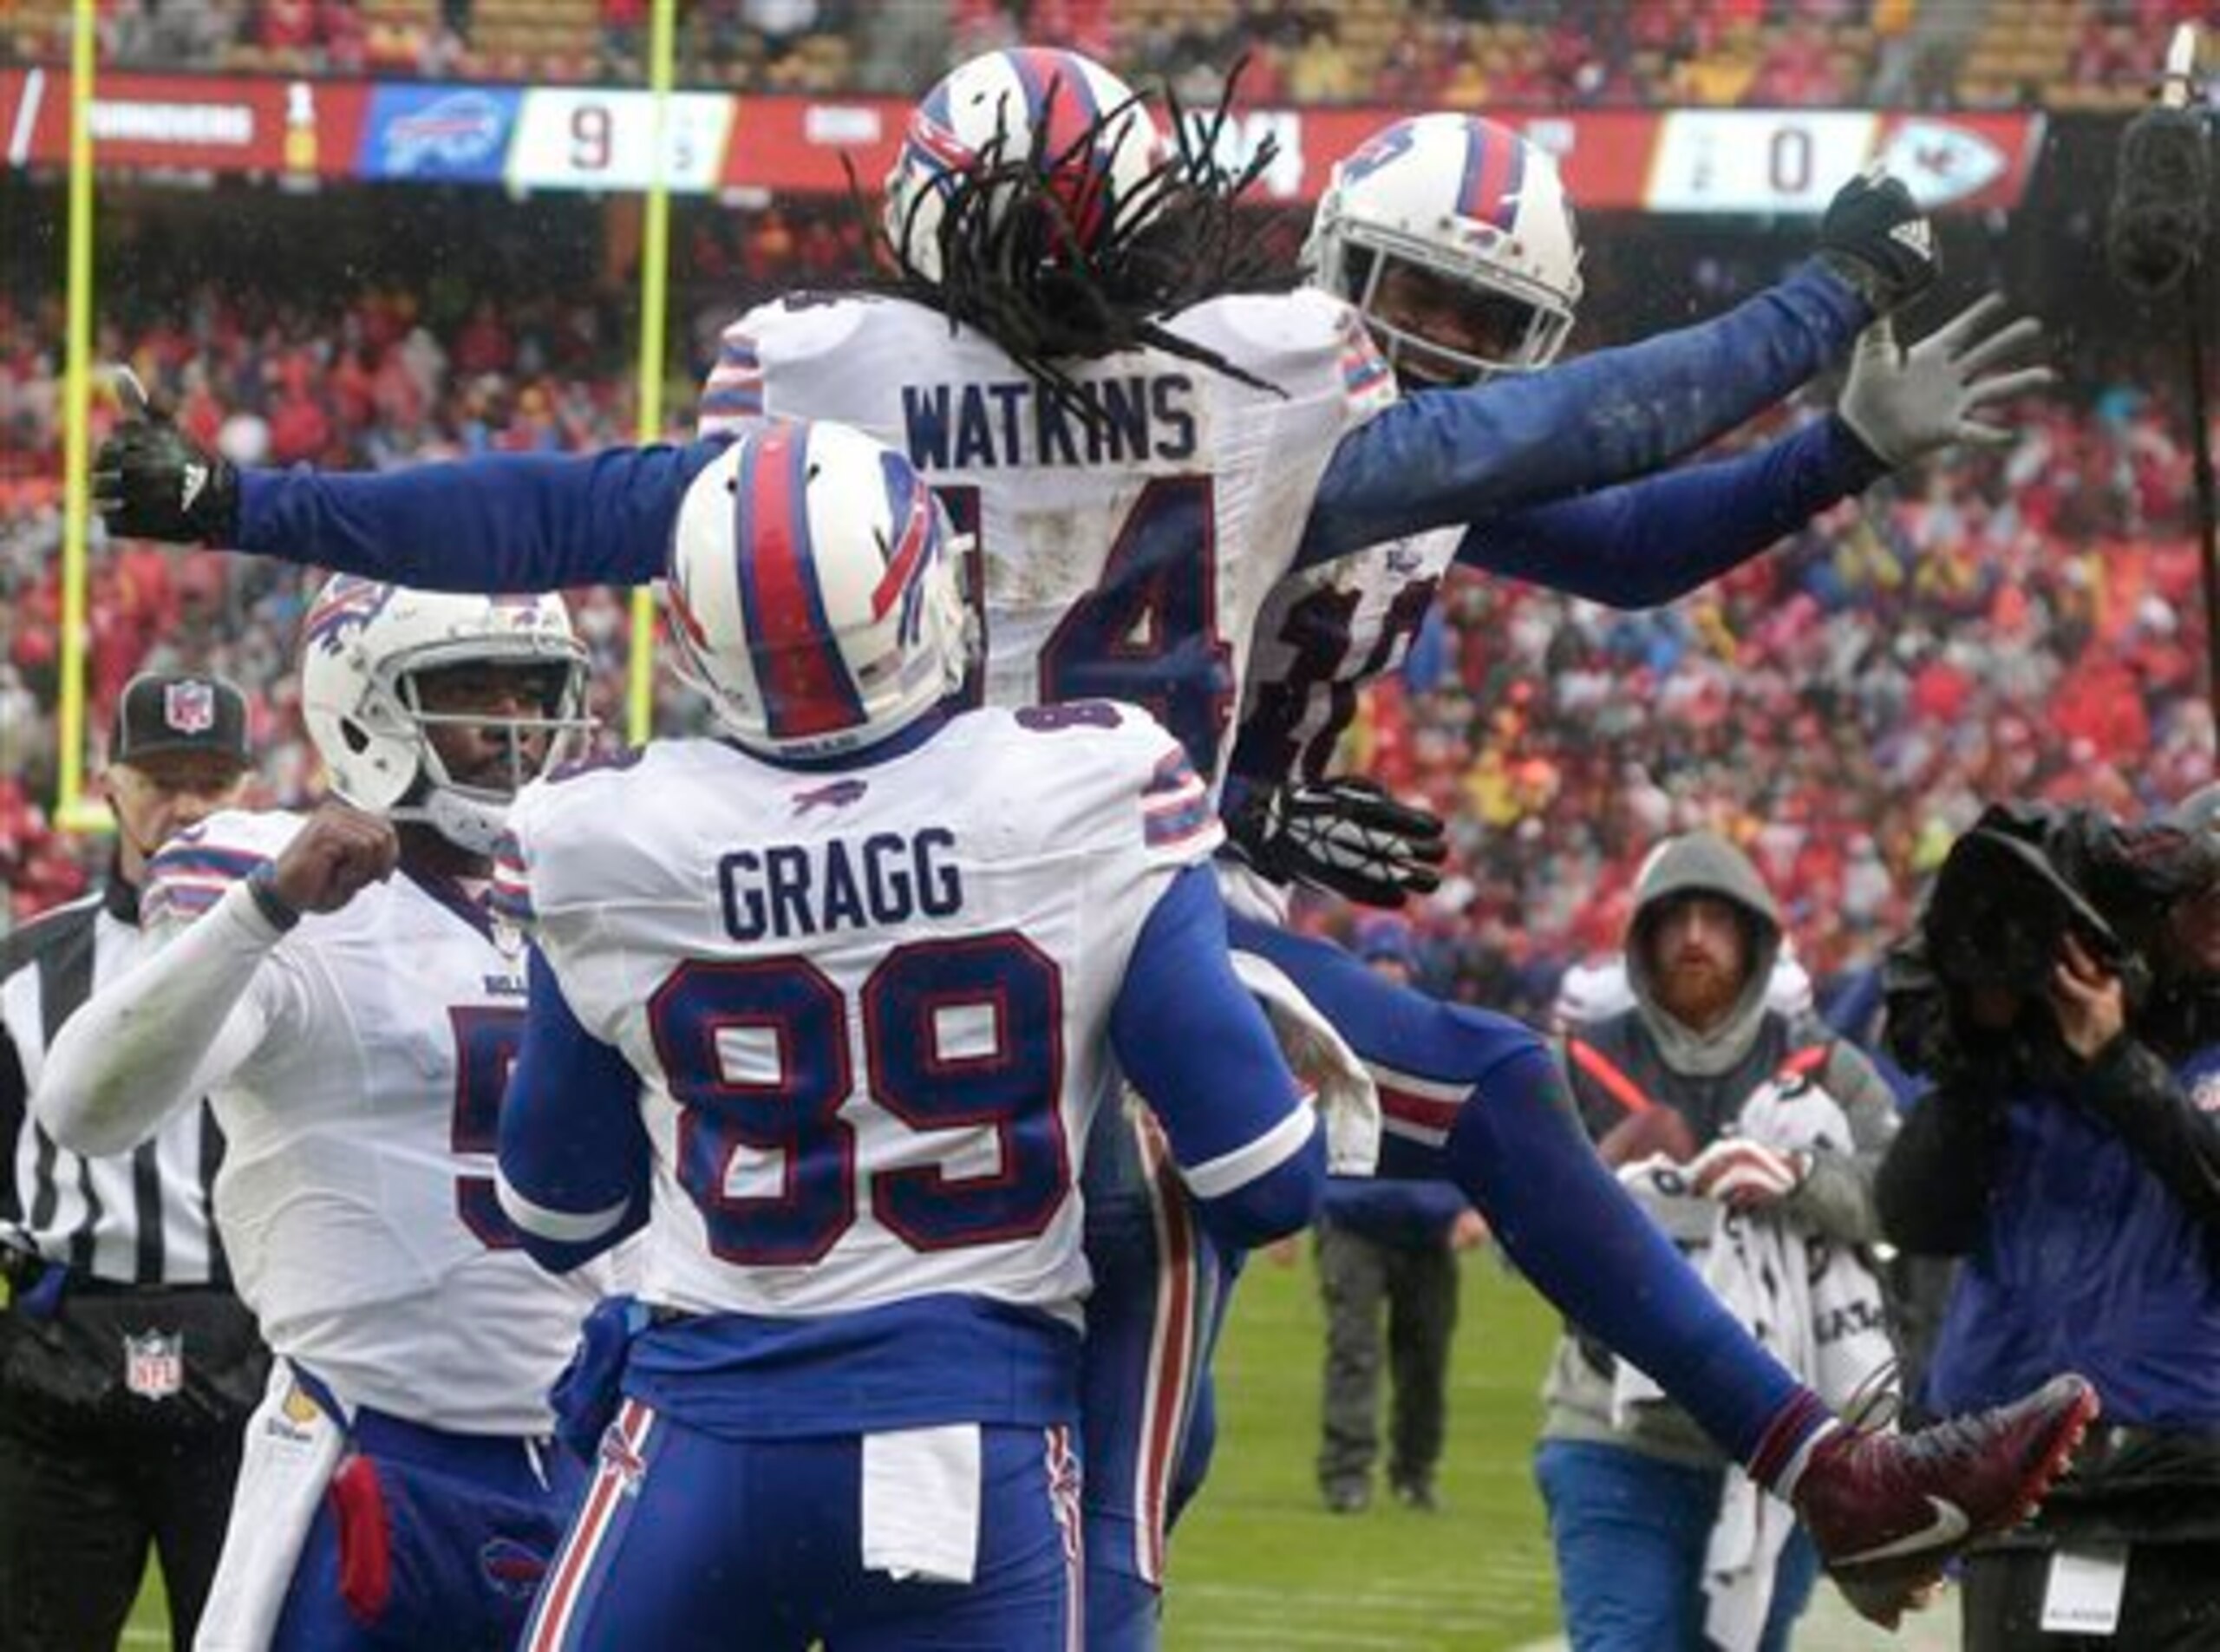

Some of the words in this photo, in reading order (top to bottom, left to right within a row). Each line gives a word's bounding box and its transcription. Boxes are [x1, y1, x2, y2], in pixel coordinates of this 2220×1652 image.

[569, 104, 614, 171] 9
[1767, 127, 1814, 194] 0
[902, 374, 1196, 469] WATKINS
[718, 827, 963, 942] GRAGG
[646, 928, 1071, 1266] 89
